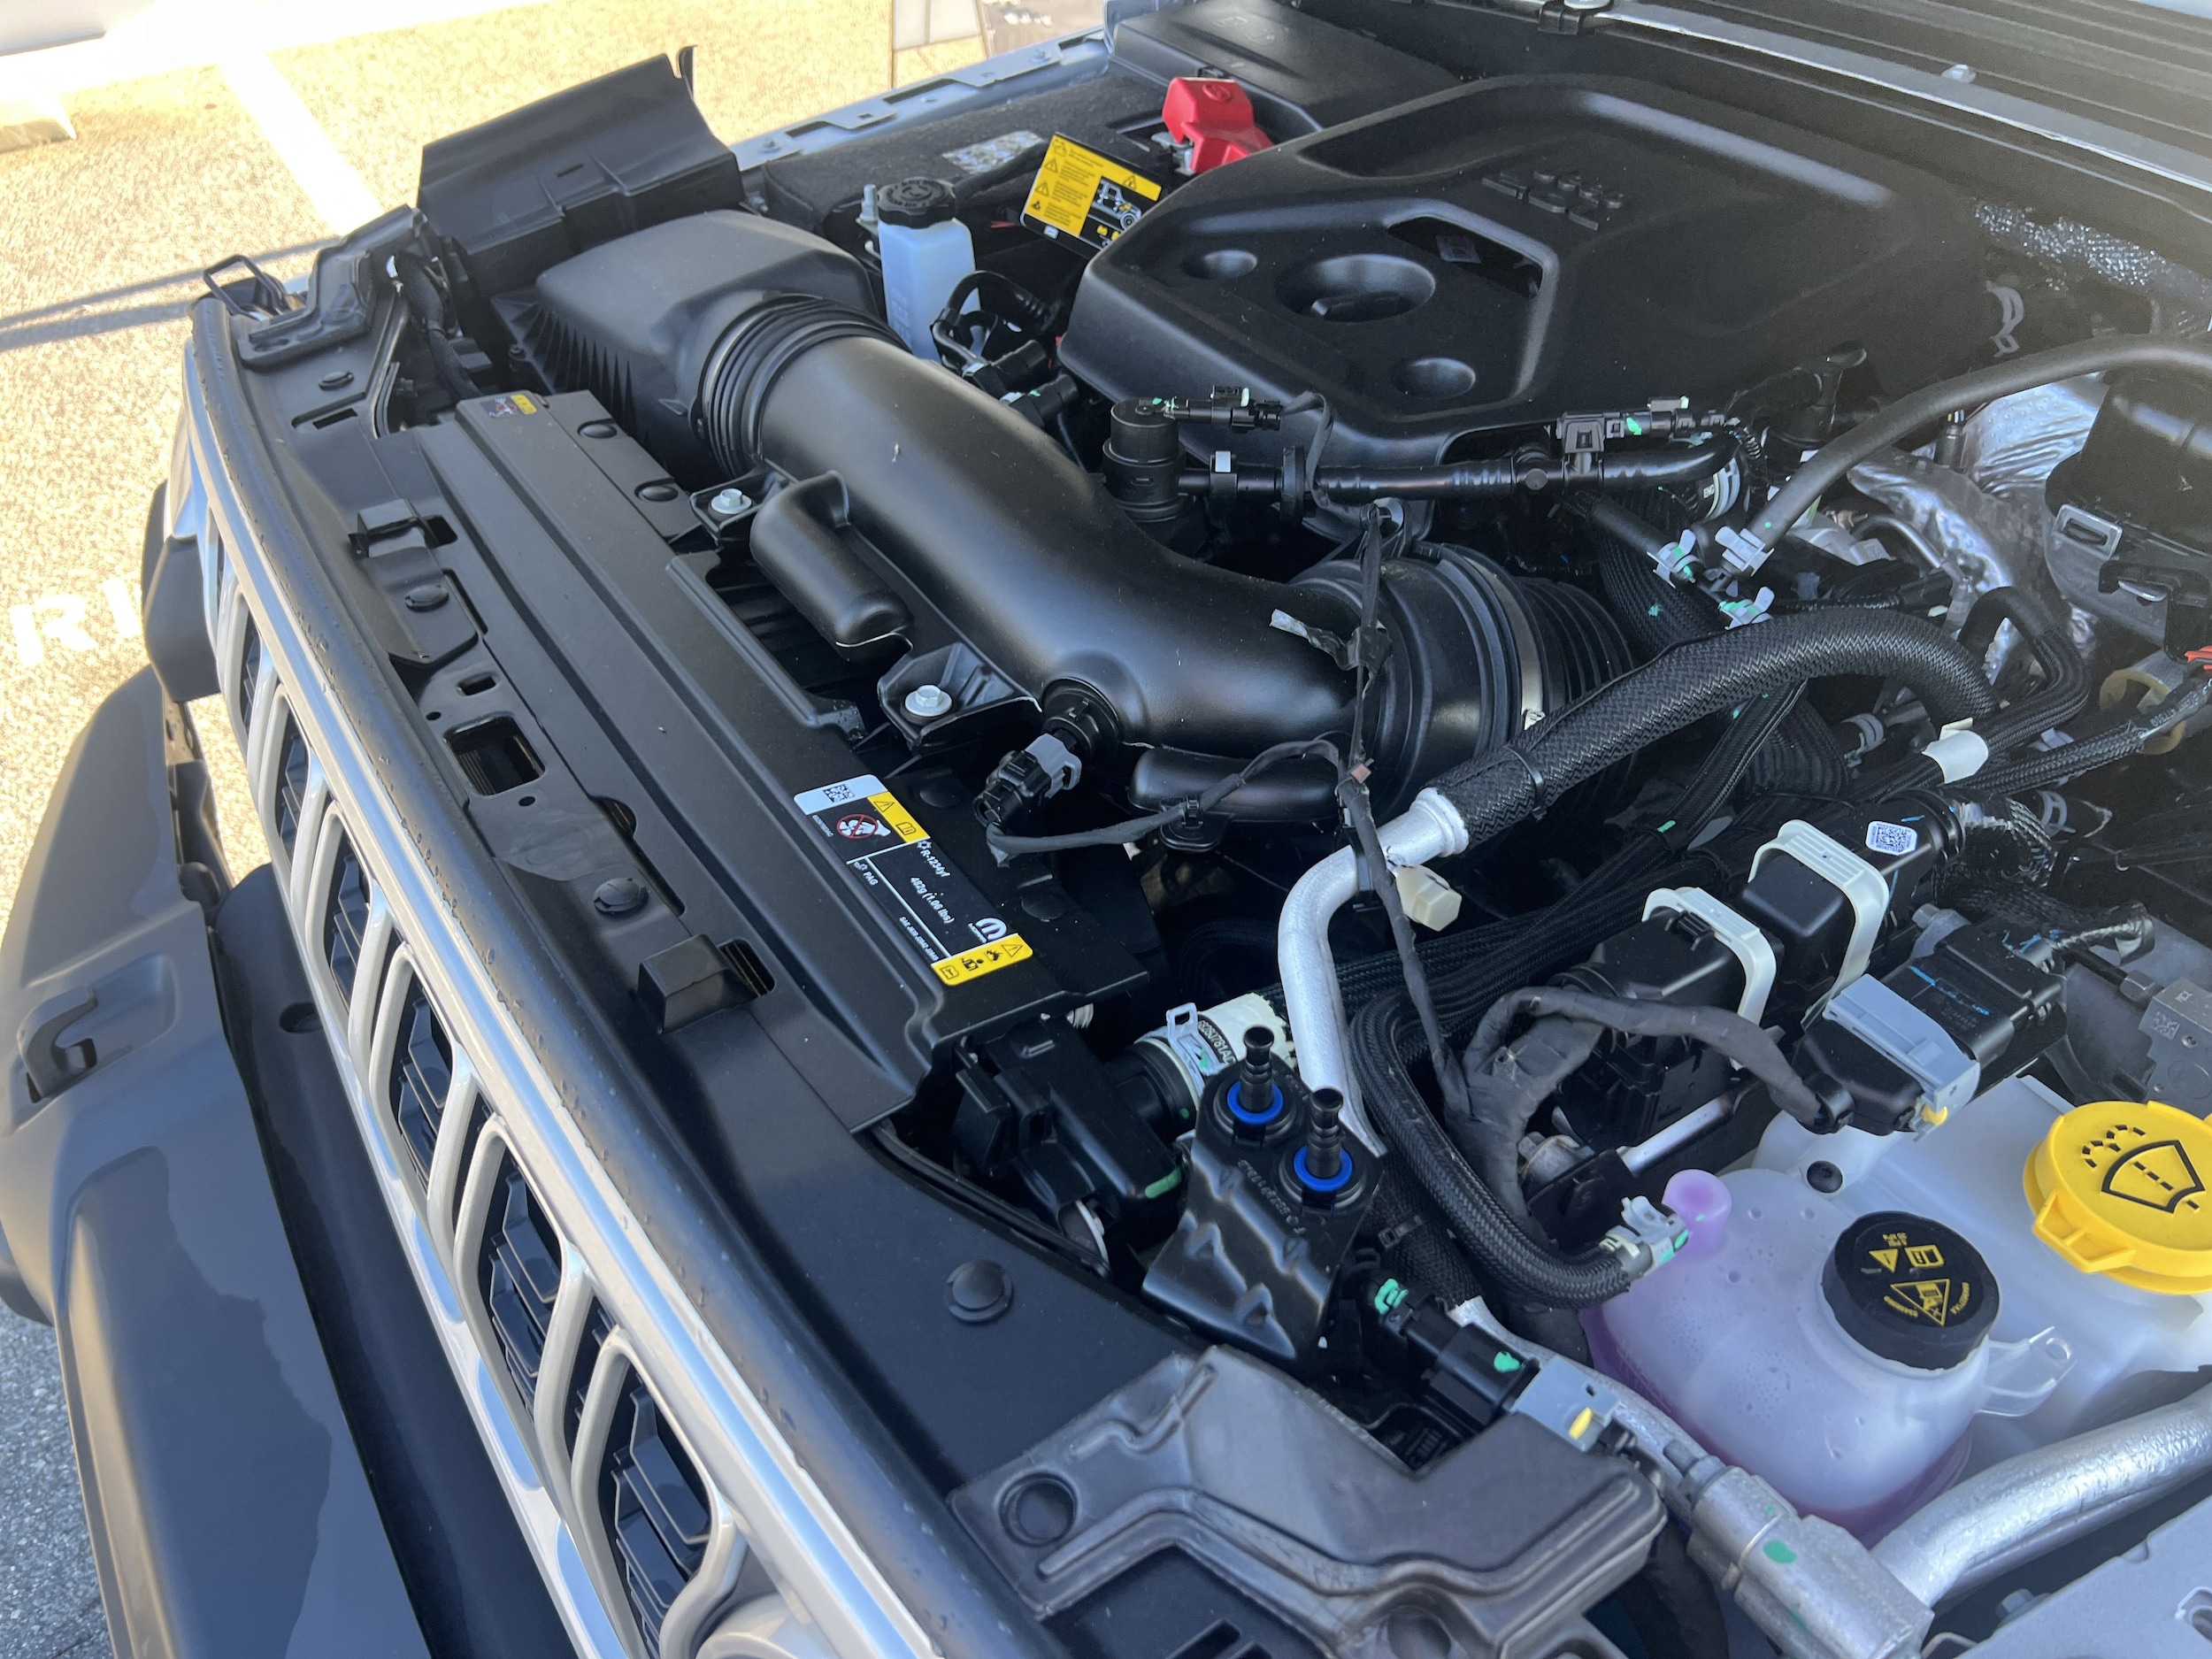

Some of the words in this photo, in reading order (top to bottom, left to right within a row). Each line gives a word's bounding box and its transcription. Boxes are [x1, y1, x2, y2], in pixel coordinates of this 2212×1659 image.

[920, 849, 951, 878] R-1234yf
[863, 871, 879, 886] PAG
[910, 877, 928, 895] 482g
[938, 908, 955, 924] lbs)
